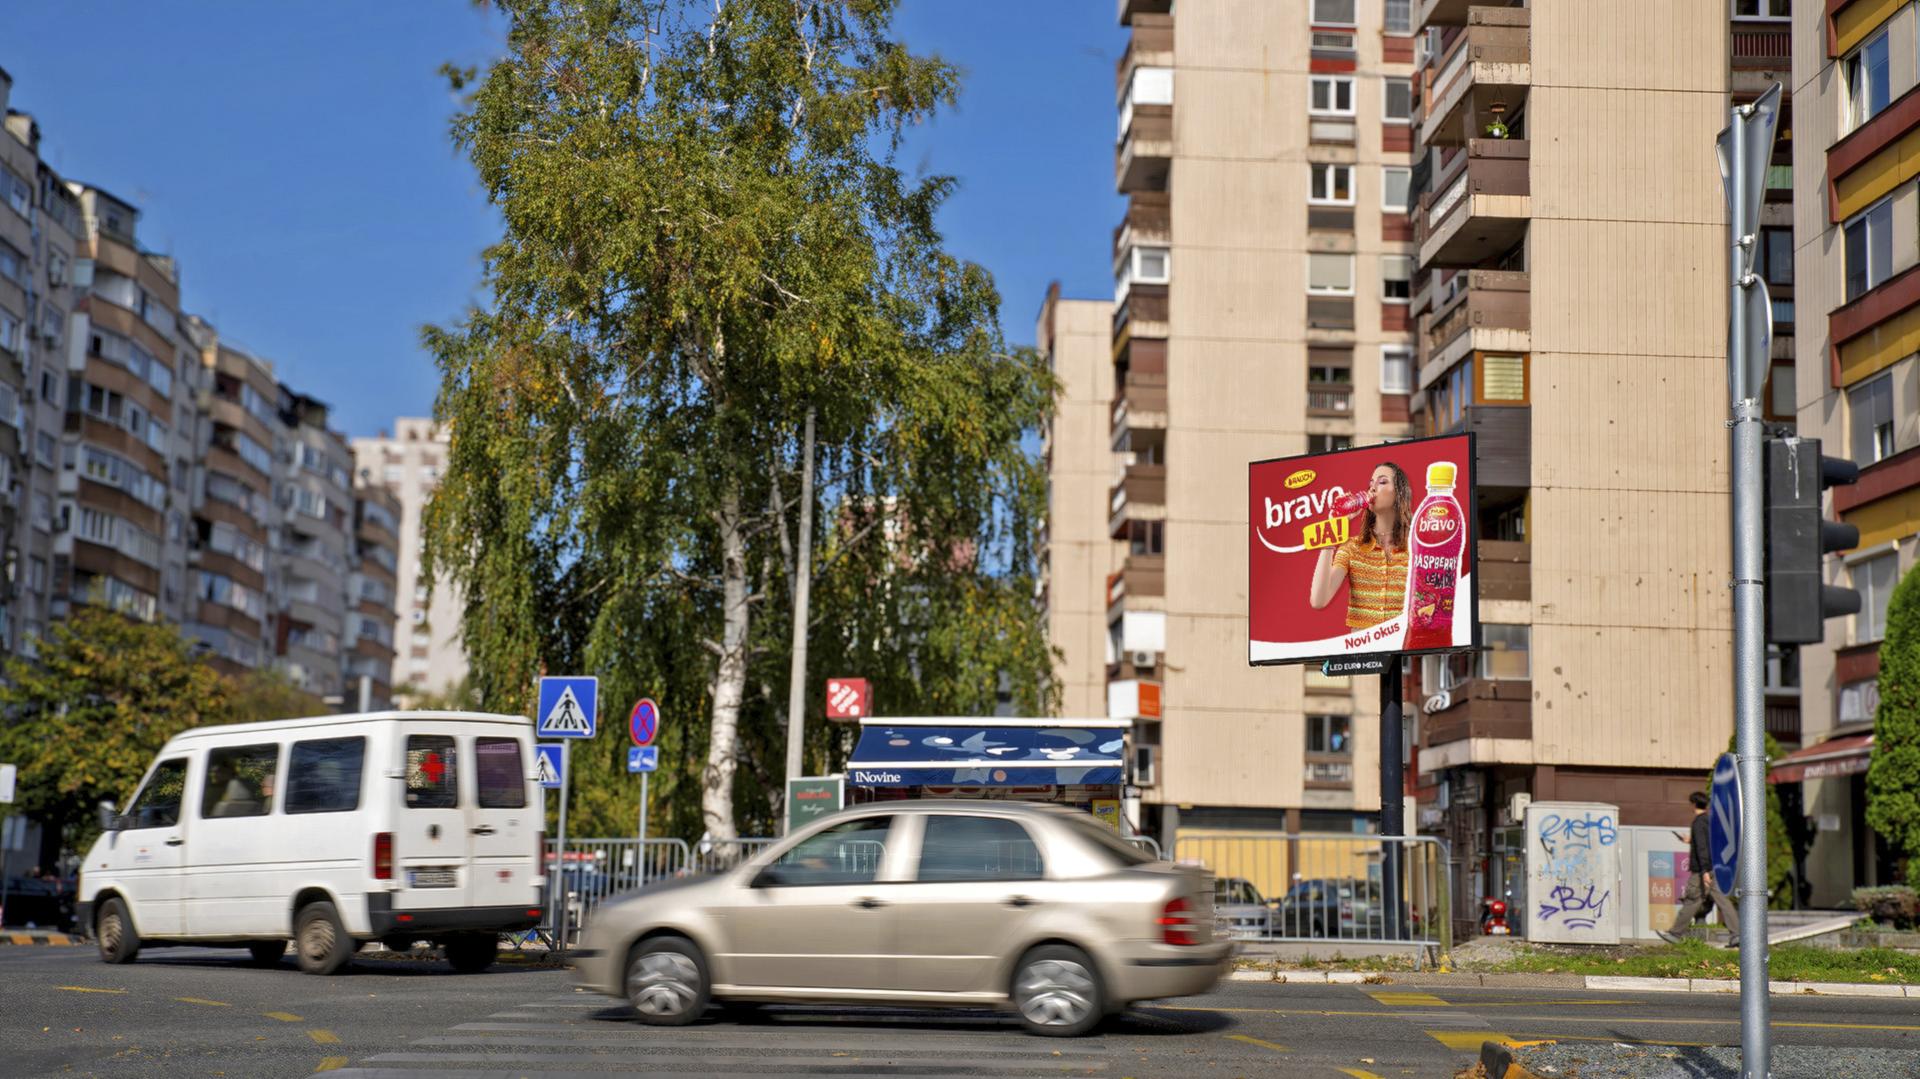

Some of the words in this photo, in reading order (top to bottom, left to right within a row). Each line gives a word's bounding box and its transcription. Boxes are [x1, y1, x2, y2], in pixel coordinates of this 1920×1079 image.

[1309, 519, 1343, 547] JA!
[1419, 517, 1455, 533] bravo
[1413, 554, 1457, 571] RASPBERRY
[1344, 631, 1371, 649] Novi
[1374, 623, 1400, 640] okus
[1344, 662, 1361, 670] EURO
[1362, 661, 1383, 669] MEDIA
